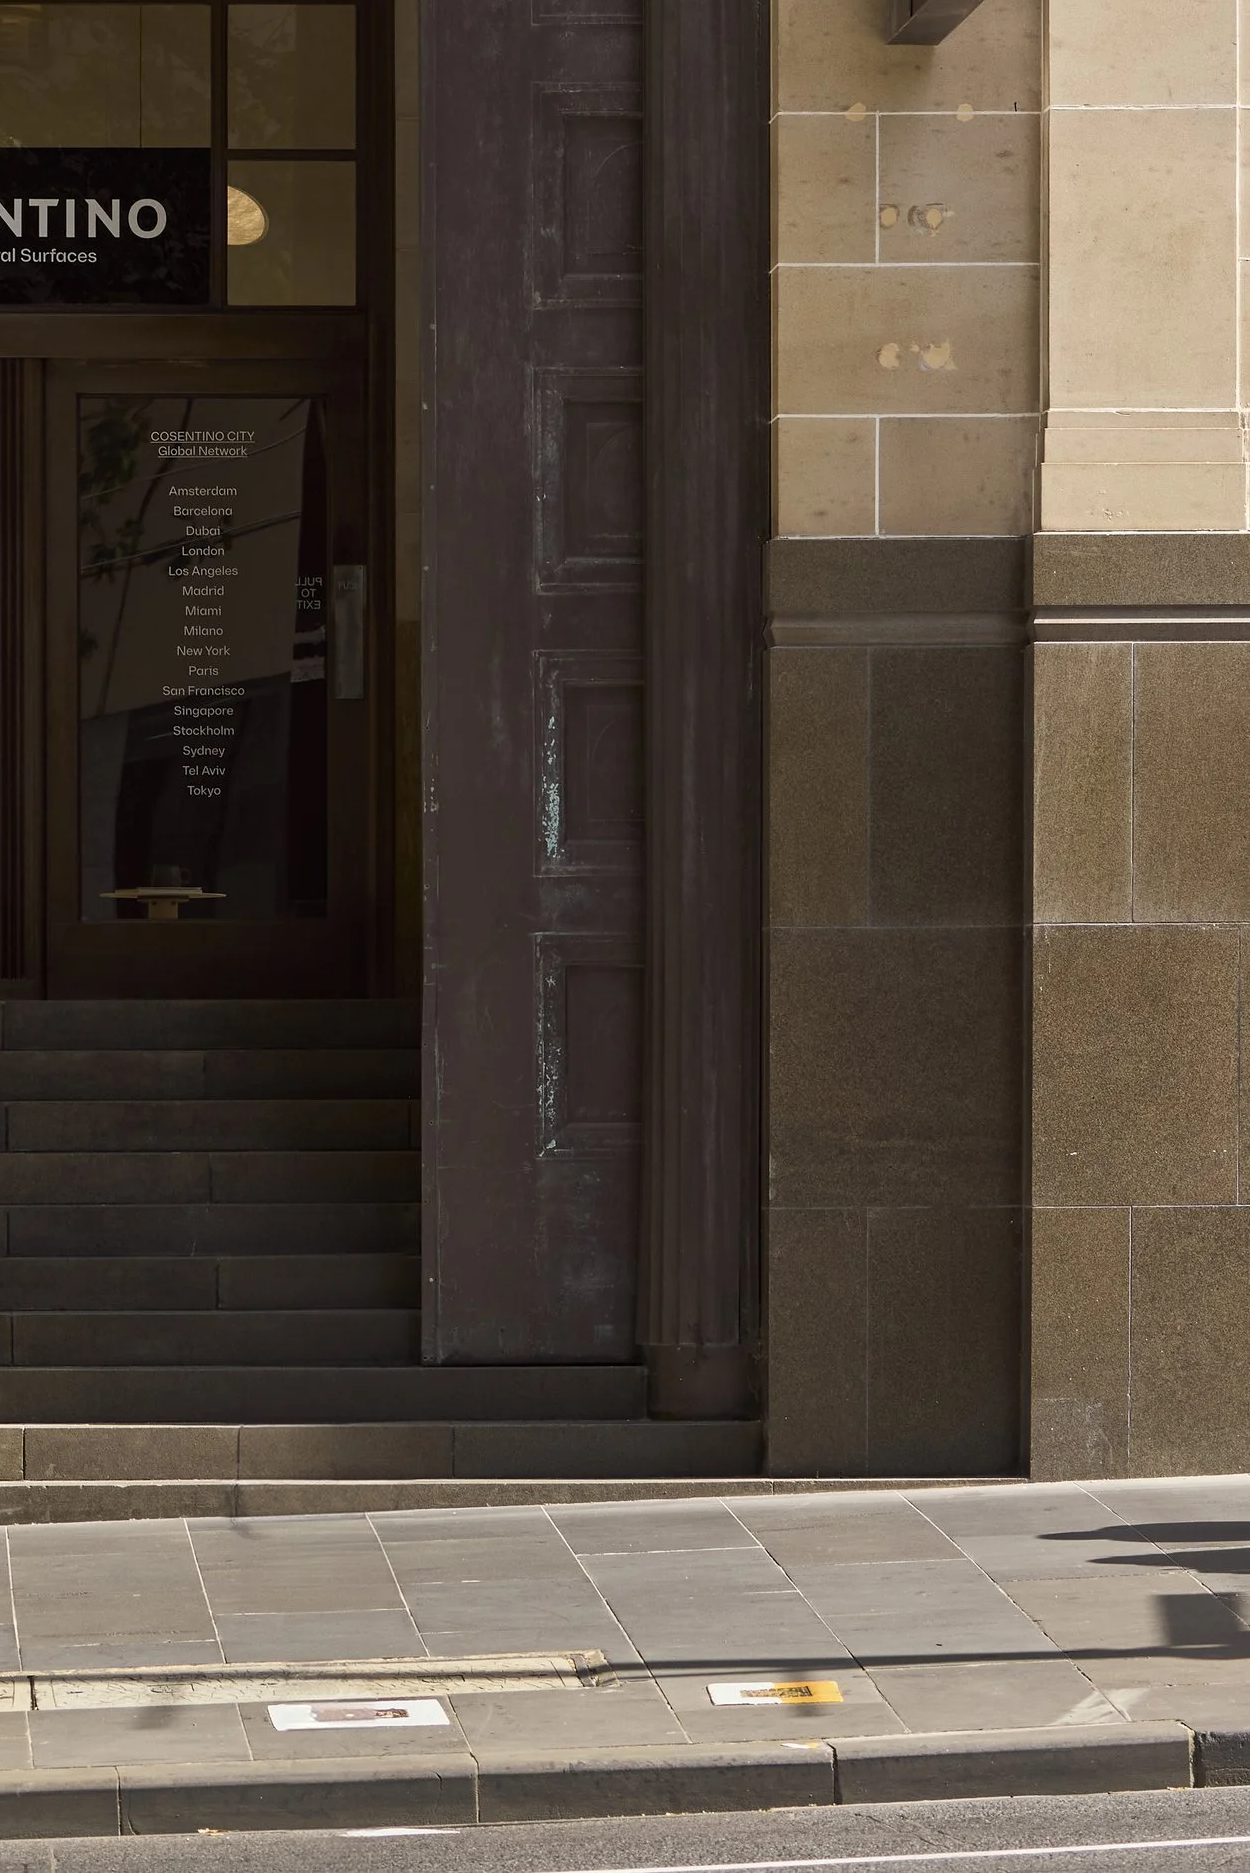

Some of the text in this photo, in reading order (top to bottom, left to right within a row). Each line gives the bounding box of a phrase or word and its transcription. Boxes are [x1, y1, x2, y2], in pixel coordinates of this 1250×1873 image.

[21, 248, 97, 263] Surfaces
[150, 431, 255, 442] COSENTINO CITY
[158, 445, 248, 457] Global Network
[169, 485, 238, 496] Amsterdam
[173, 505, 233, 516] Barcelona
[186, 525, 221, 536] Dubai
[181, 545, 225, 556] London
[168, 566, 238, 579] Los Angeles
[182, 585, 225, 596] Madrid
[185, 605, 222, 616] Miami
[183, 626, 224, 636] Milano
[176, 645, 231, 656] New York
[188, 665, 219, 676] Paris
[162, 685, 245, 696] San Francisco
[174, 705, 234, 718] Singapore
[173, 725, 235, 736] Stockholm
[182, 745, 226, 758] Sydney
[182, 765, 226, 776] Tel Aviv
[187, 785, 222, 798] Tokyo
